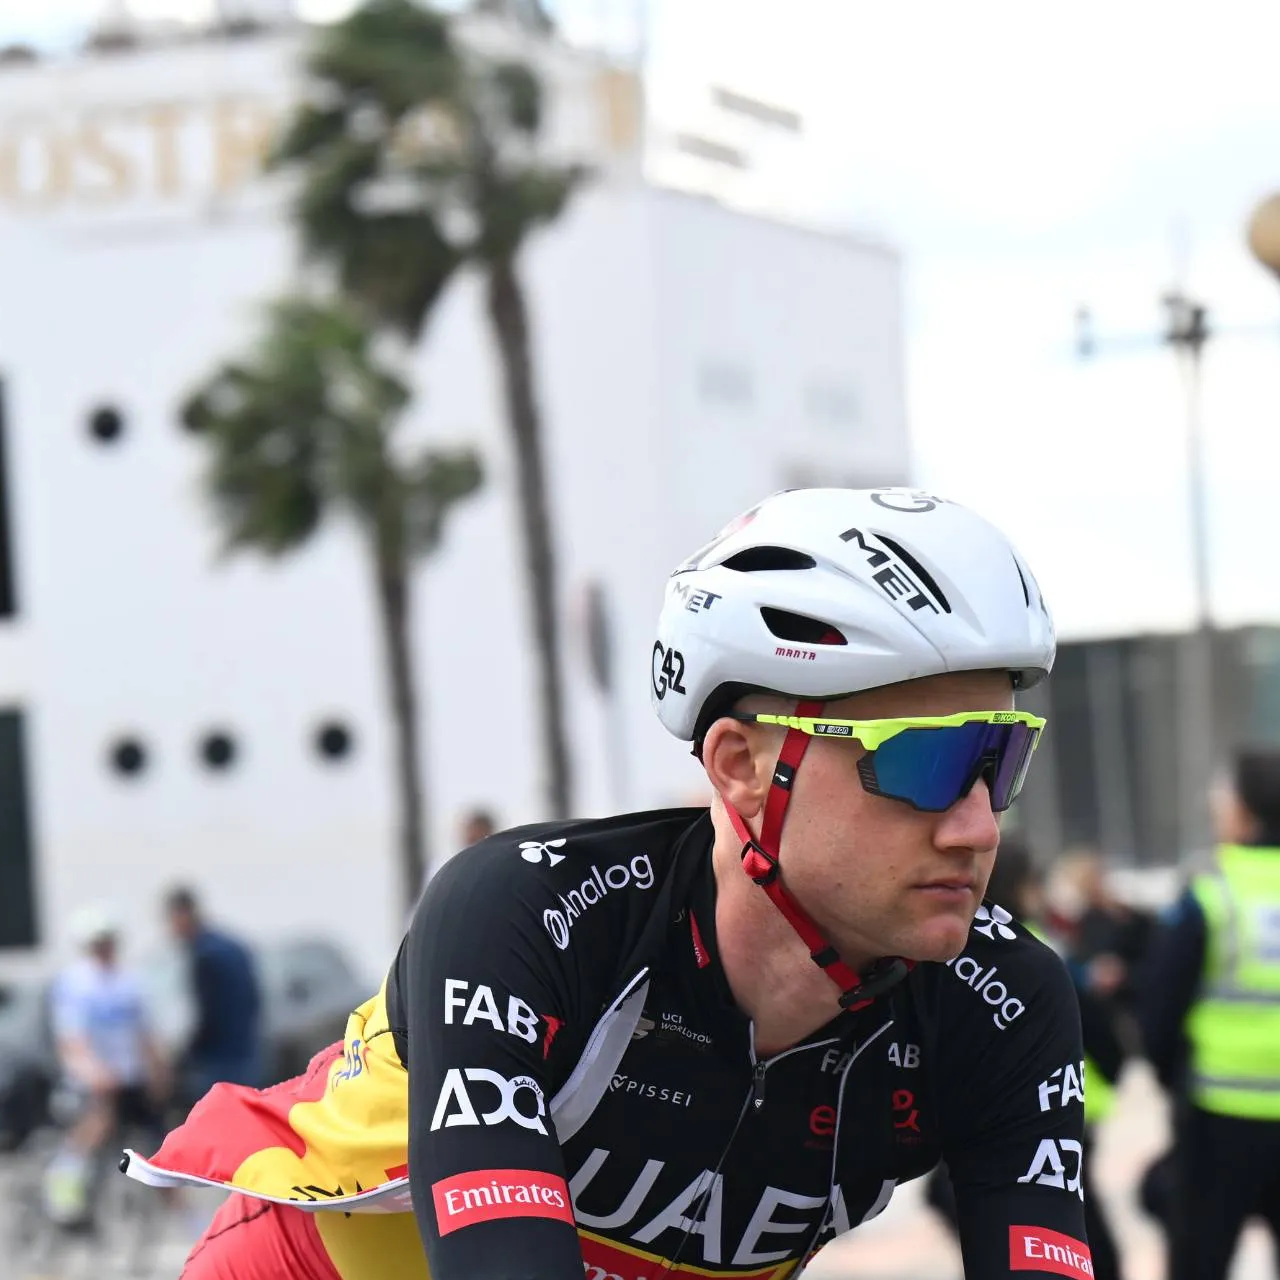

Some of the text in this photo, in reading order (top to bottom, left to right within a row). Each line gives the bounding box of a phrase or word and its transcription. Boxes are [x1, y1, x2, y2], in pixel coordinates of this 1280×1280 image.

[671, 581, 722, 613] MET
[838, 527, 940, 615] MET
[652, 640, 686, 700] G42
[662, 1012, 682, 1024] UCI
[430, 1068, 549, 1136] ADQ
[626, 1081, 692, 1107] PISSEI
[445, 1181, 565, 1217] Emirates
[1017, 1138, 1084, 1202] AD
[568, 1148, 829, 1265] UAE
